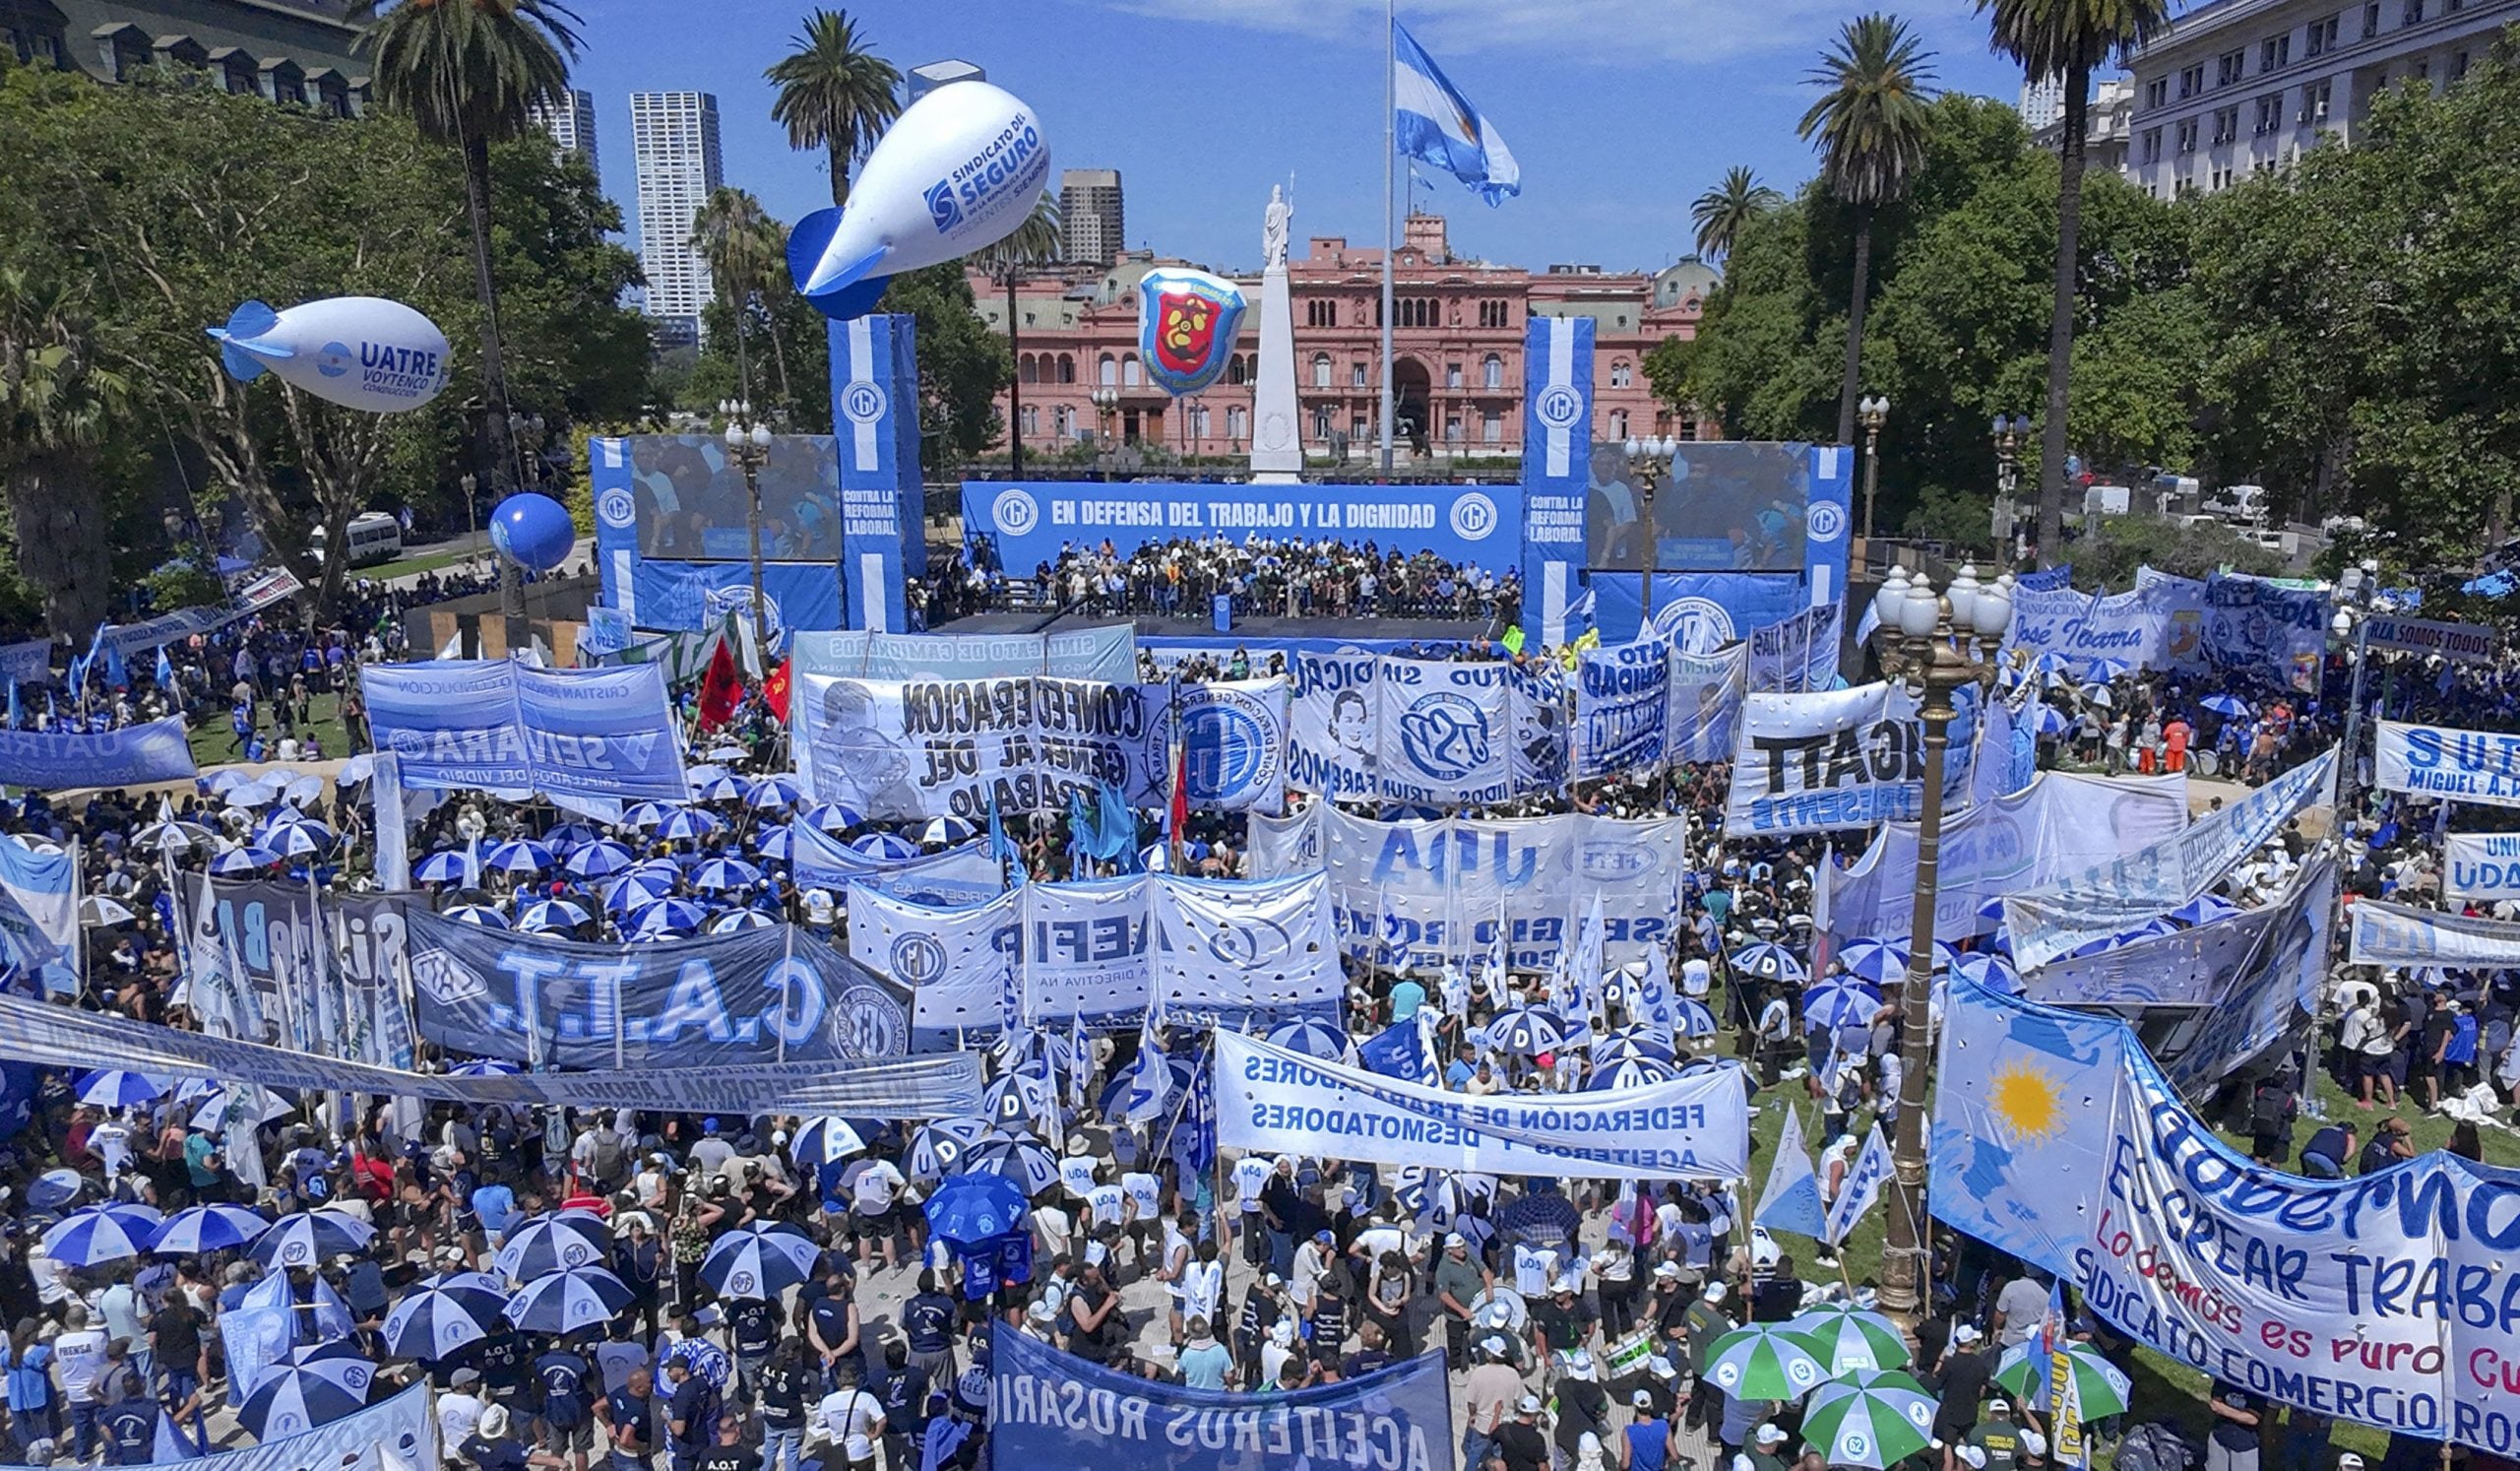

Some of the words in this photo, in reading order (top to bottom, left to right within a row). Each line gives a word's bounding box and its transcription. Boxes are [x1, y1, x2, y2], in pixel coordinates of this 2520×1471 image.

[952, 128, 1013, 183] SINDICATO
[1011, 112, 1026, 133] DEL
[960, 126, 1038, 206] SEGURO
[951, 196, 1012, 240] PRESENTES
[361, 341, 436, 377] UATRE
[363, 368, 429, 391] VOYTENCO
[844, 490, 880, 503] CONTRA
[882, 490, 895, 503] LA
[1531, 496, 1569, 509] CONTRA
[1571, 496, 1584, 509] LA
[845, 504, 896, 519] REFORMA
[1051, 500, 1076, 525] EN
[1081, 500, 1164, 526] DEFENSA
[1168, 502, 1203, 527] DEL
[1208, 502, 1294, 528] TRABAJO
[1299, 503, 1311, 528] Y
[1317, 503, 1341, 528] LA
[1347, 503, 1436, 529] DIGNIDAD
[1531, 511, 1583, 525] REFORMA
[846, 520, 898, 537] LABORAL
[1530, 527, 1583, 543] LABORAL
[2013, 614, 2054, 649] José
[2398, 623, 2442, 649] SOMOS
[2445, 632, 2490, 657] TODOS
[2407, 768, 2478, 795] MIGUEL
[1068, 1168, 1090, 1180] UDA
[2108, 1134, 2149, 1216] ES
[2165, 1186, 2309, 1302] CREAR
[58, 1343, 93, 1357] PRENSA
[708, 1459, 739, 1471] A.O.T
